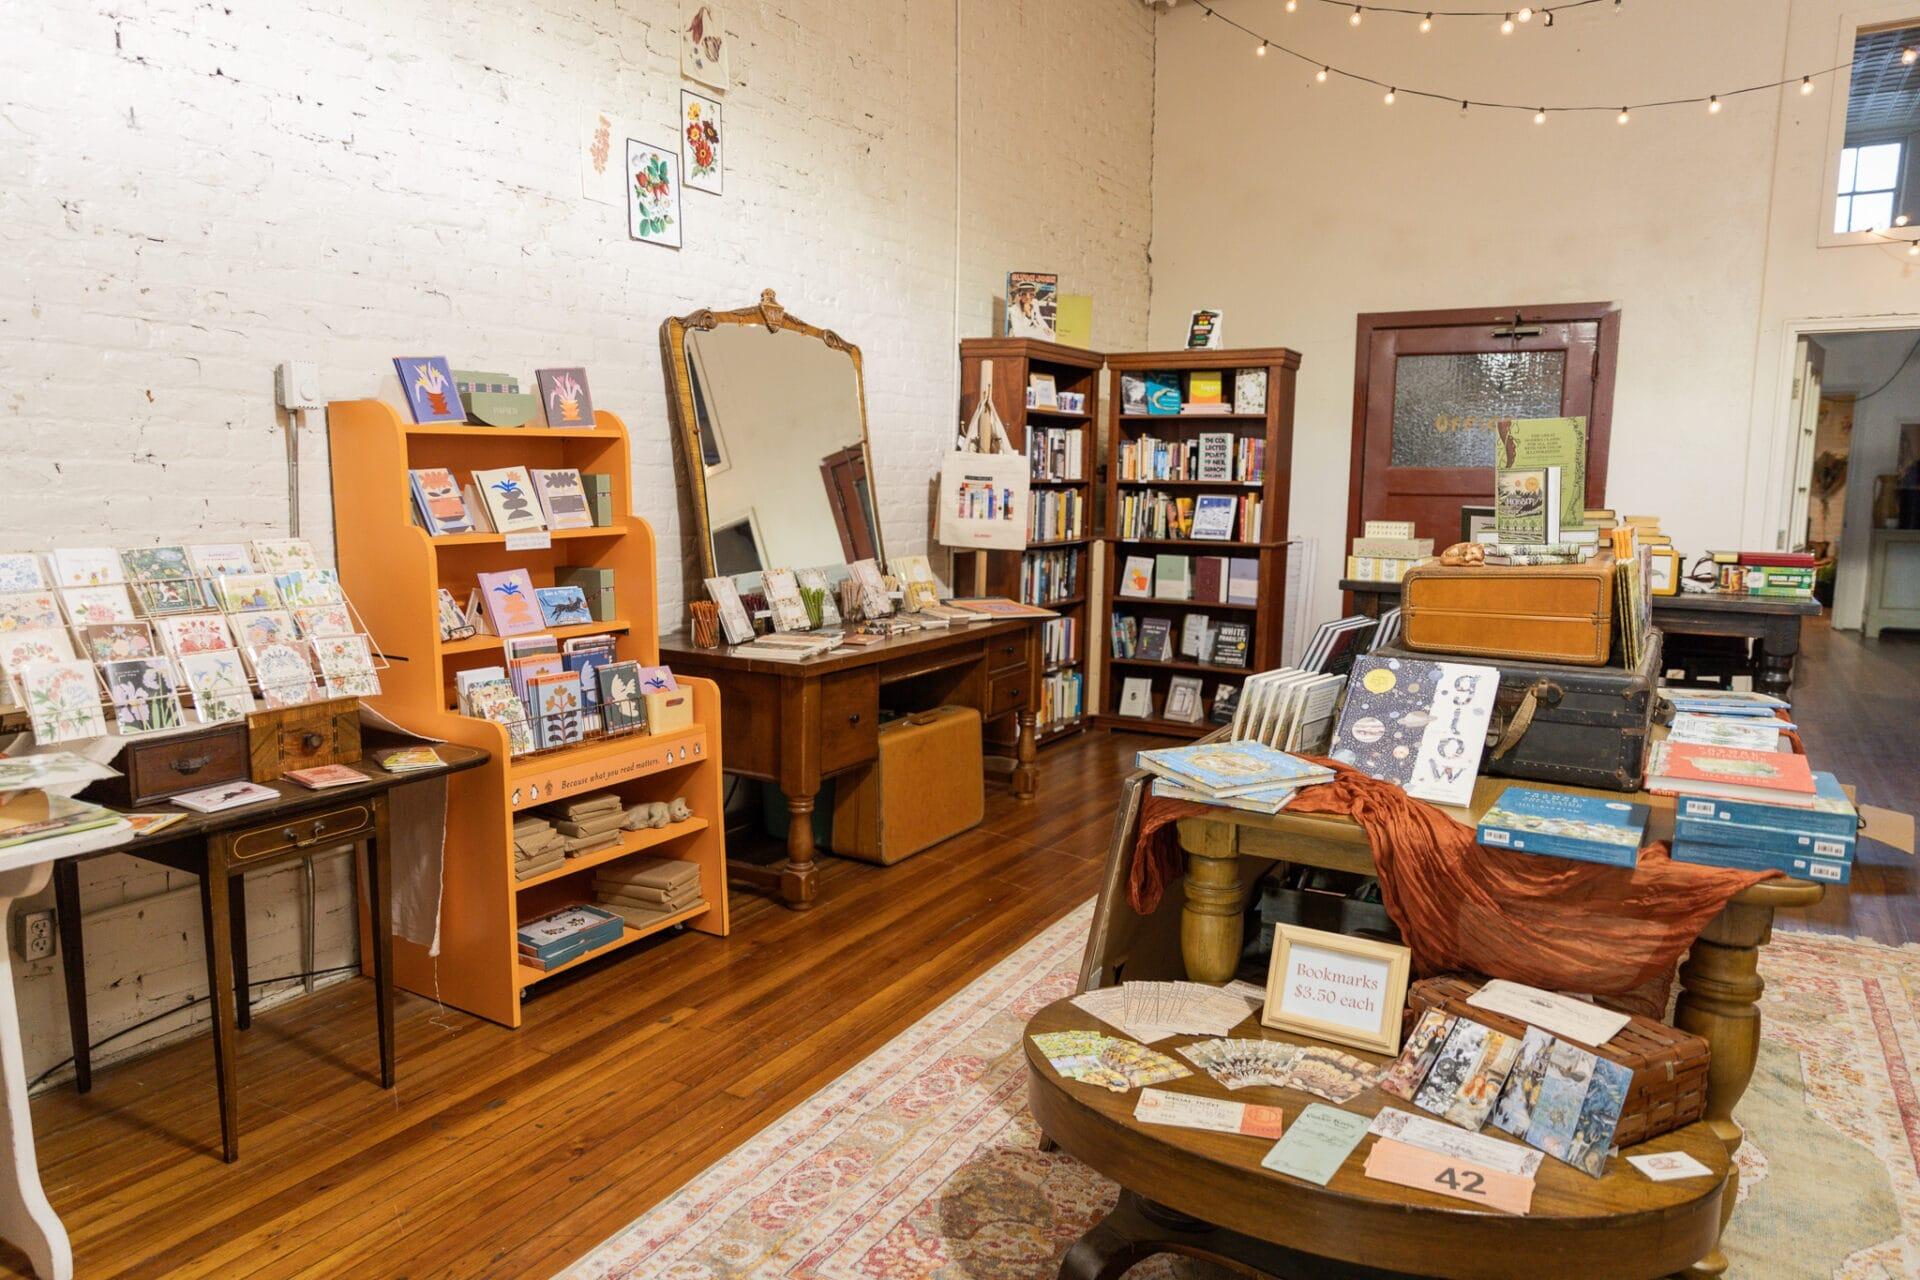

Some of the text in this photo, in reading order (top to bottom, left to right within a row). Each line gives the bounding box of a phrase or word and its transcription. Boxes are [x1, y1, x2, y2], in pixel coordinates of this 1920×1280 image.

[1434, 415, 1500, 433] OFFIC
[1221, 627, 1246, 637] WHITE
[561, 758, 661, 790] Because what you read matters.
[1296, 963, 1379, 990] Bookmarks
[1294, 984, 1375, 1012] $3.50 each
[1434, 1167, 1487, 1195] 42
